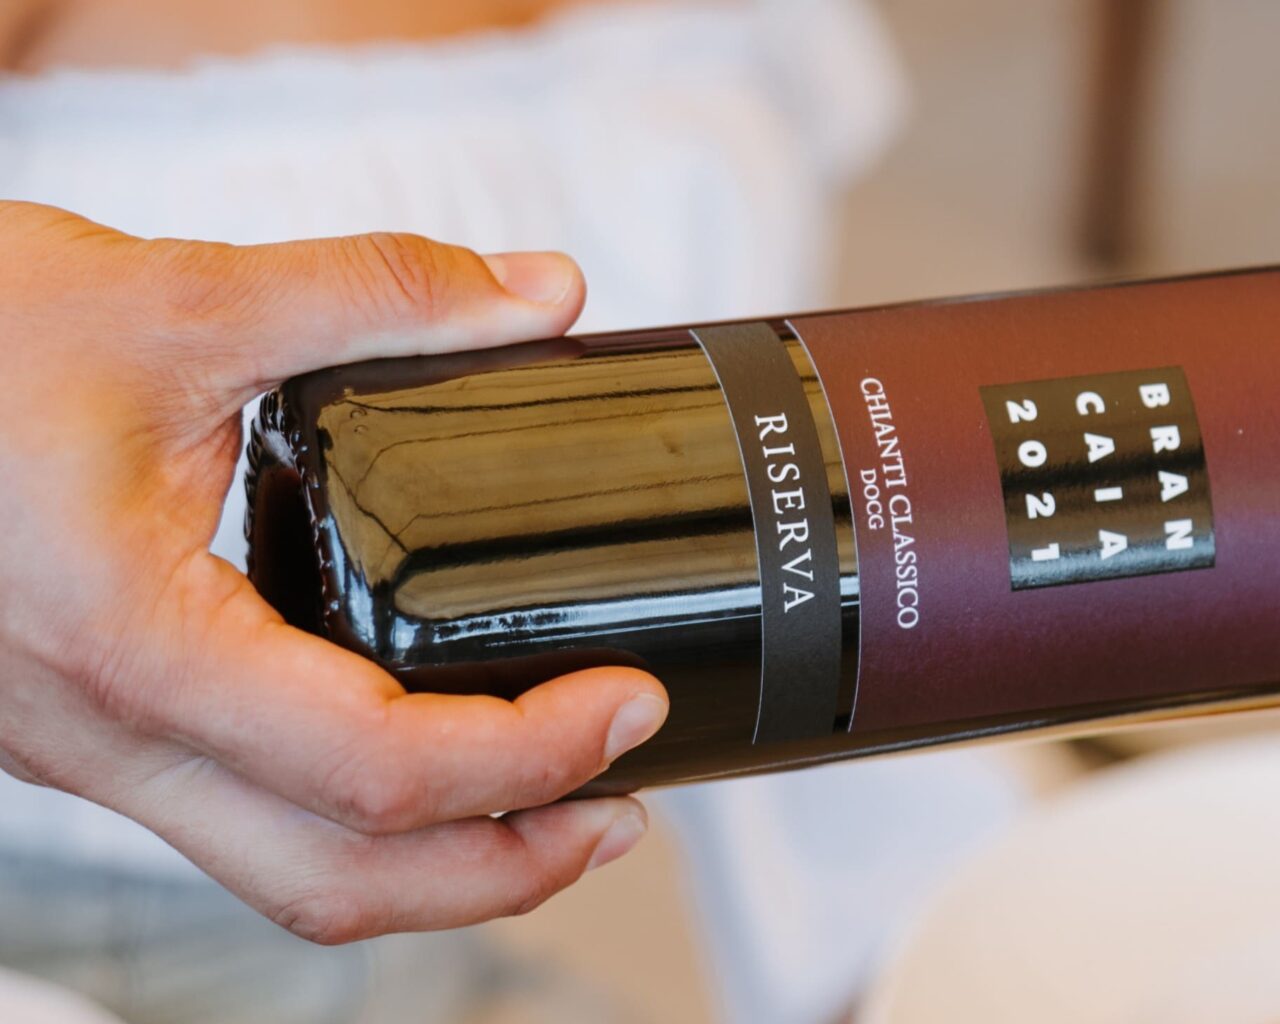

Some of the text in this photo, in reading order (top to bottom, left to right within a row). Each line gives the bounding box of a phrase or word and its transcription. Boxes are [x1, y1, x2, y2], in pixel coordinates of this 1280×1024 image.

[754, 412, 815, 613] RISERVA
[860, 469, 884, 530] DOCG
[860, 377, 919, 629] CHIANTI CLASSICO
[1006, 399, 1060, 561] 2021
[1076, 391, 1127, 559] CAIA
[1139, 384, 1193, 550] BRAN
